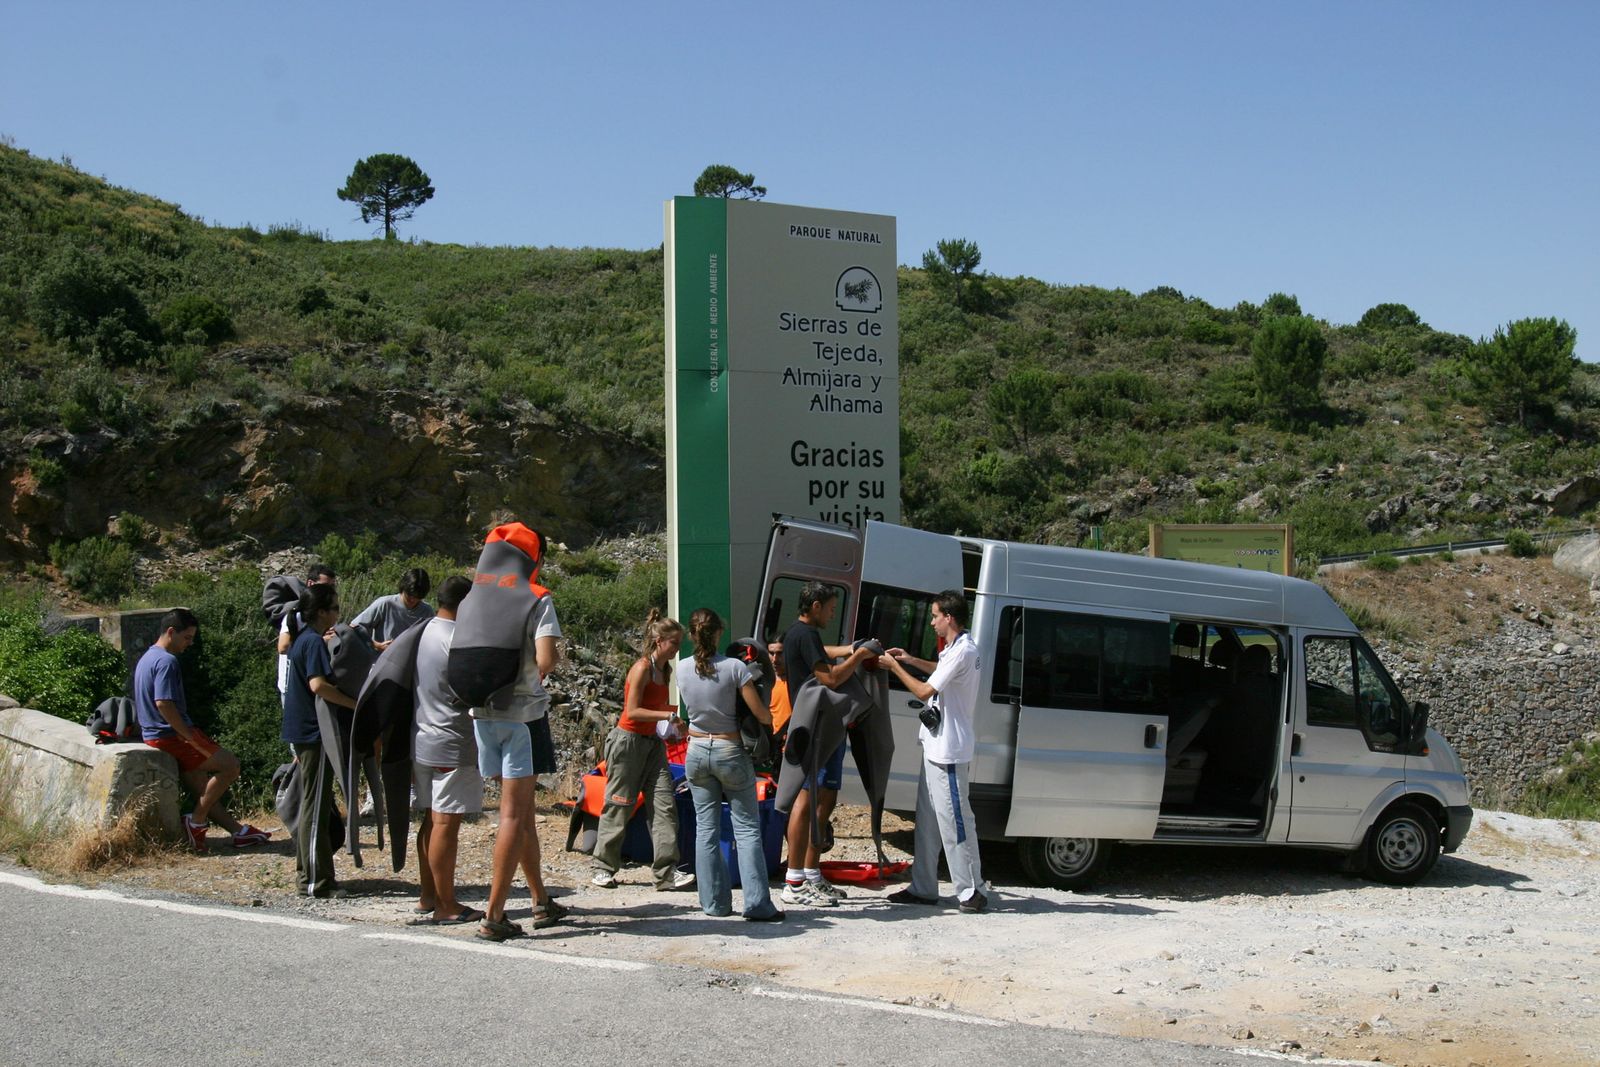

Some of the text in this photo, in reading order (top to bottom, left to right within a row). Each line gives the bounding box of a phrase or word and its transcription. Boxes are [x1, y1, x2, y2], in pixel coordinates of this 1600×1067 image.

[790, 225, 881, 244] PARQUE NATURAL
[709, 253, 718, 294] AMBIENTE
[710, 298, 718, 325] MEDIO
[779, 312, 882, 336] Sierras de
[710, 329, 718, 339] DE
[813, 341, 883, 366] Tejeda,
[782, 367, 882, 393] Almijara y
[809, 394, 883, 414] Alhama
[790, 440, 884, 467] Gracias
[809, 480, 884, 505] por su
